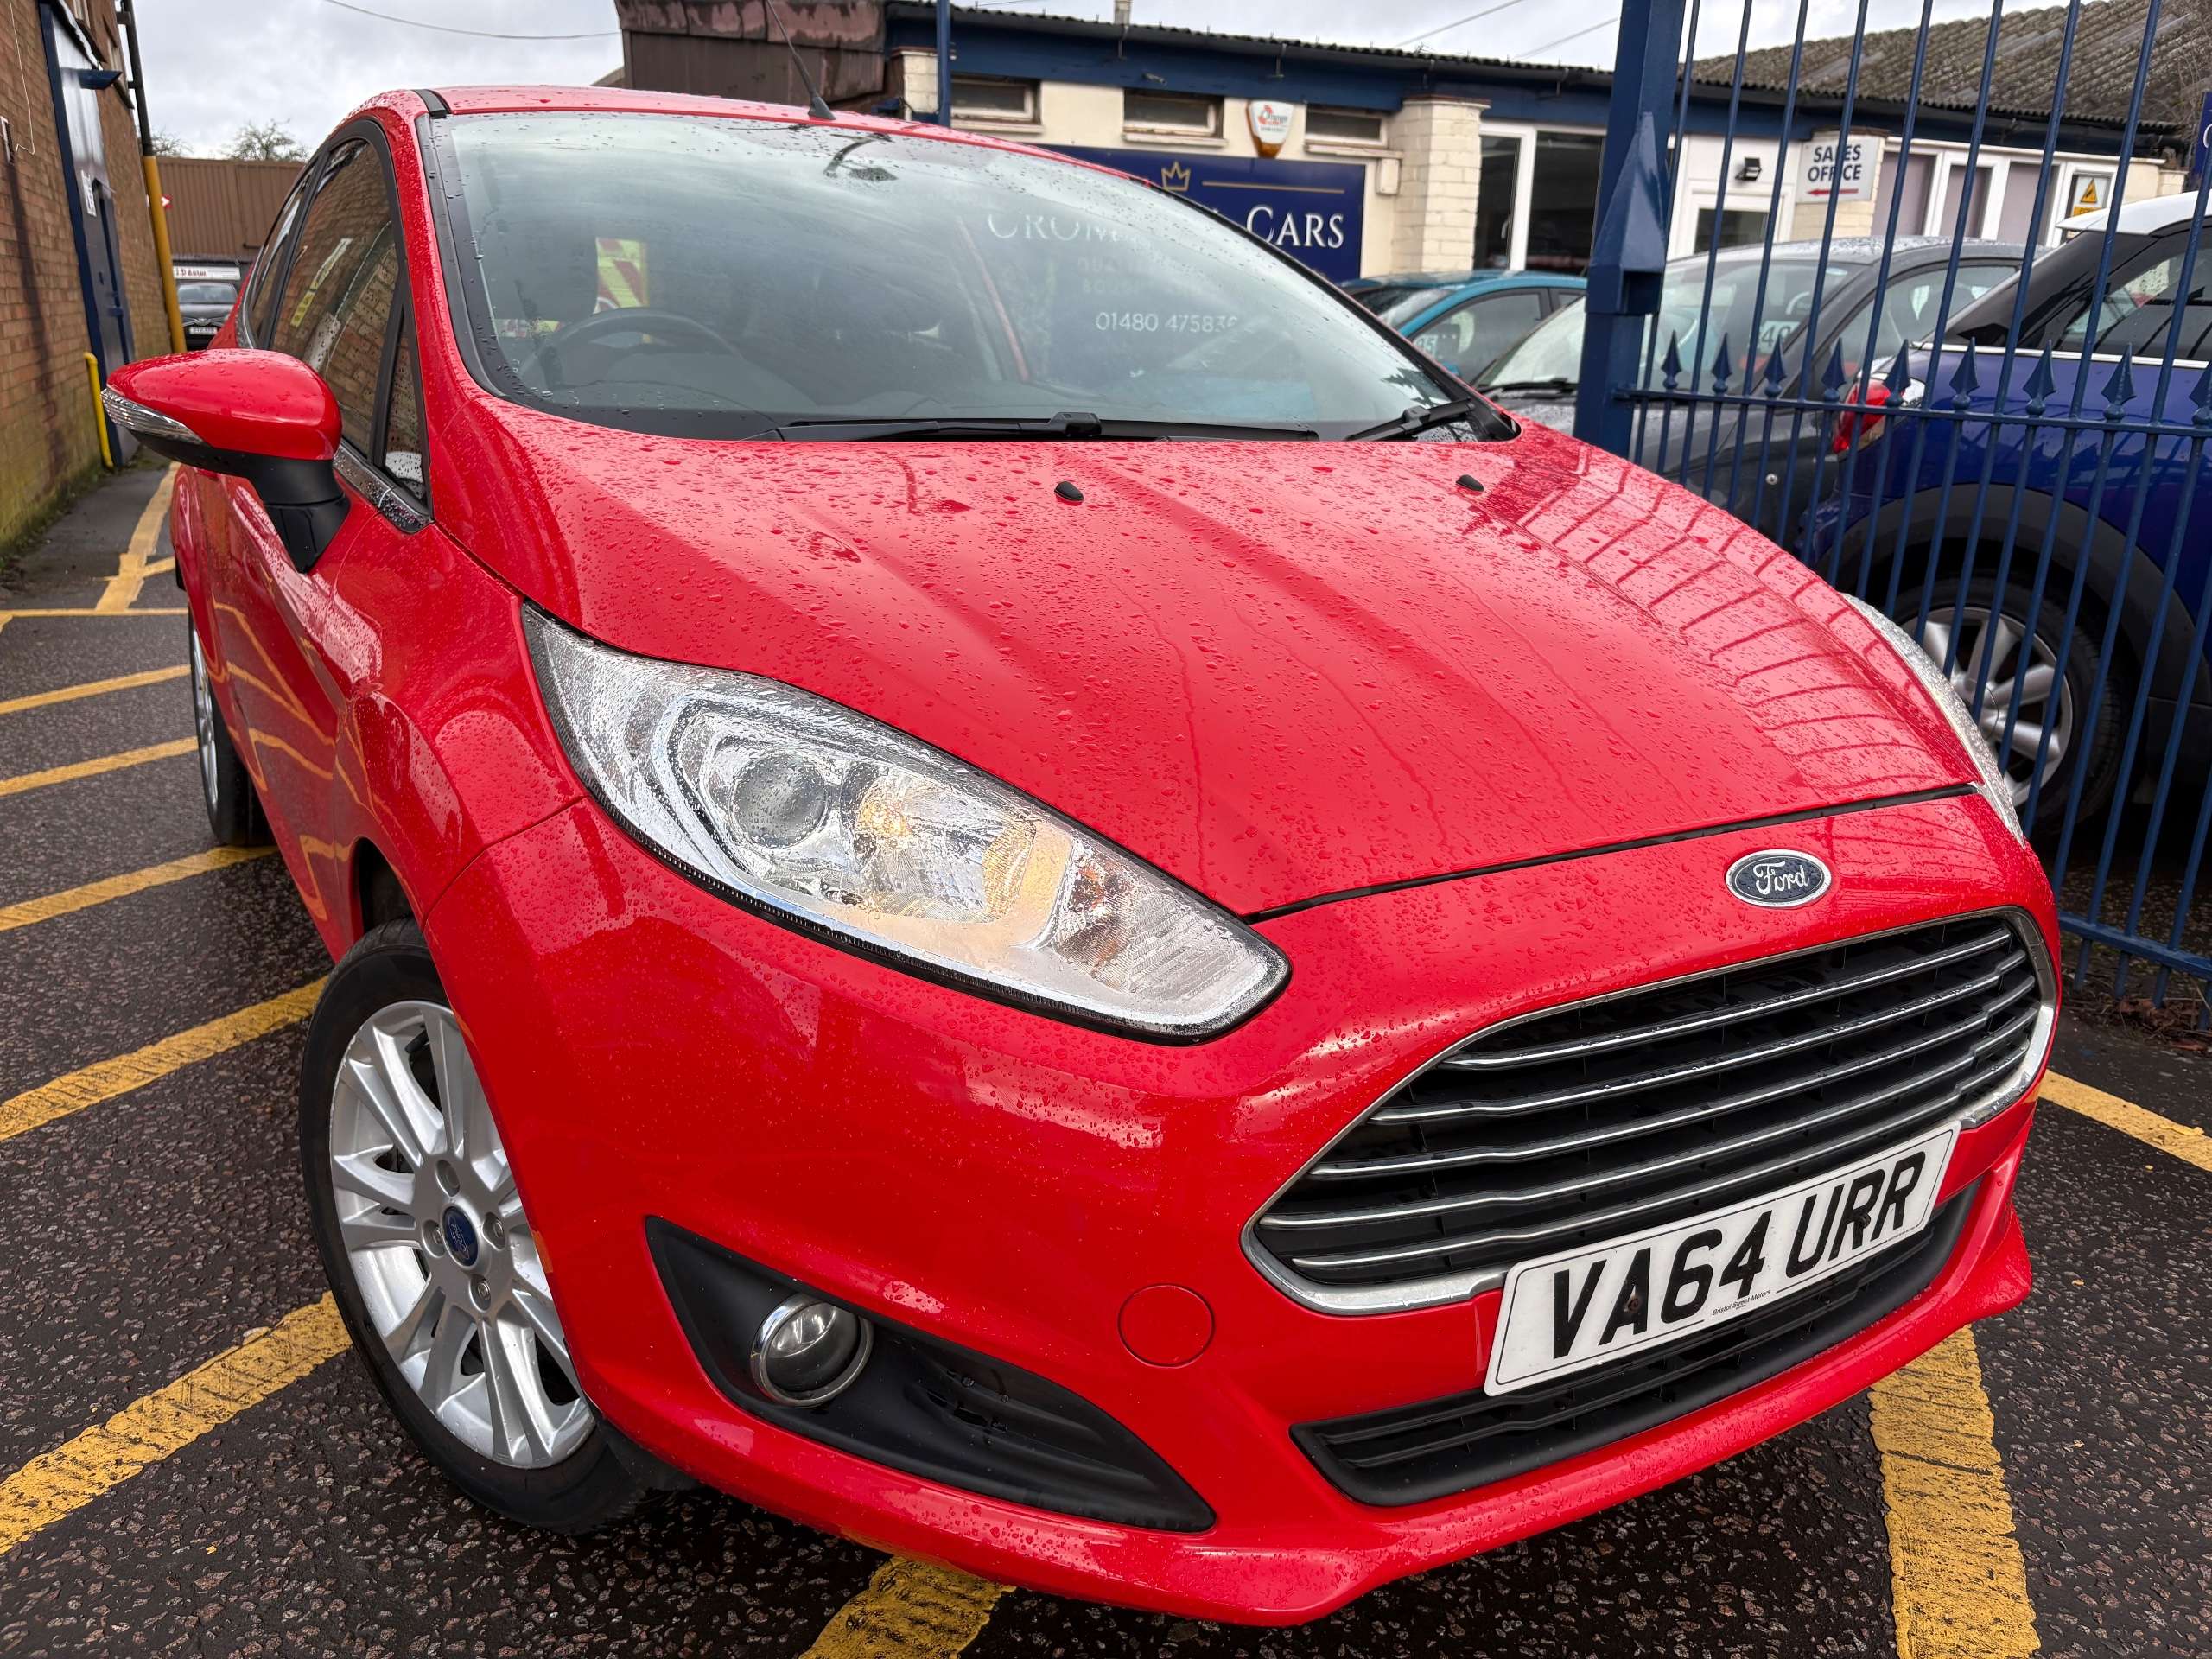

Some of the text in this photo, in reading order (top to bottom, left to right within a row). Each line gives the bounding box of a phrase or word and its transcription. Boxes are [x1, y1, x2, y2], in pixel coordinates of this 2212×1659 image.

[1813, 143, 1862, 163] SAES
[1808, 163, 1862, 182] OFFCE
[1246, 204, 1344, 249] CARS
[1095, 311, 1159, 332] 01480
[1752, 861, 1810, 895] Ford
[1554, 1151, 1926, 1359] VA64 URR
[1712, 1303, 1732, 1316] Bristol
[1732, 1297, 1751, 1309] Street
[1751, 1289, 1770, 1301] Motors
